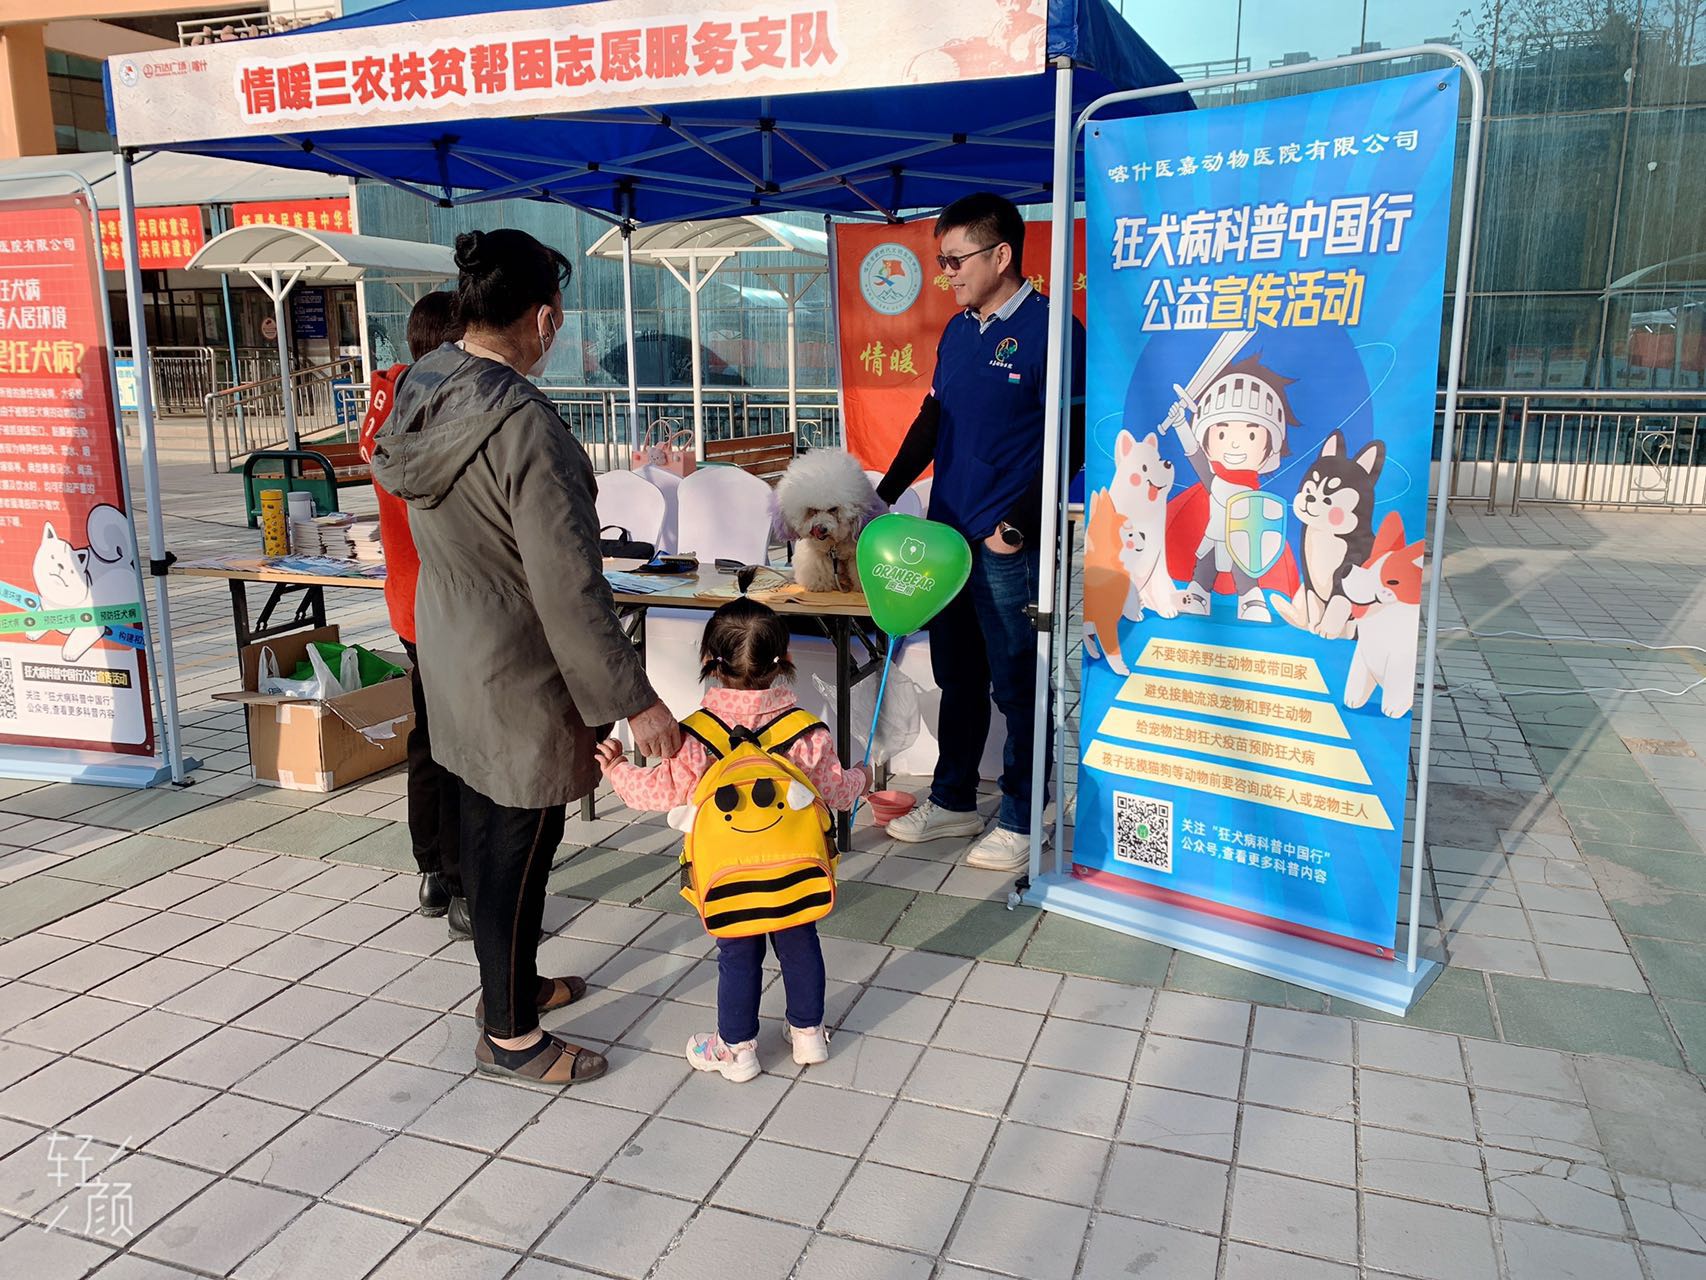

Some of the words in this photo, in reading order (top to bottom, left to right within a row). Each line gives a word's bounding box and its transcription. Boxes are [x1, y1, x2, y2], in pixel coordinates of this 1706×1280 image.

[241, 10, 838, 115] 情暖三农扶贫帮困志愿服务支队
[1108, 129, 1419, 184] 喀什医嘉动物医院有限公司
[1112, 193, 1413, 270] 狂犬病科普中国行
[0, 306, 67, 329] 人居环境
[1141, 269, 1366, 333] 公益宣传活动
[859, 340, 919, 376] 情暖
[872, 563, 935, 592] ORANBEAR
[100, 609, 137, 621] 预防狂犬病
[1151, 645, 1308, 681] 不要领养野生动物或带回家
[1144, 683, 1313, 725] 避免接触流浪宠物和野生动物
[1102, 751, 1369, 820] 孩子抚摸猫狗等动物前要咨询成年人或宠物主人
[1181, 818, 1206, 837] 关注
